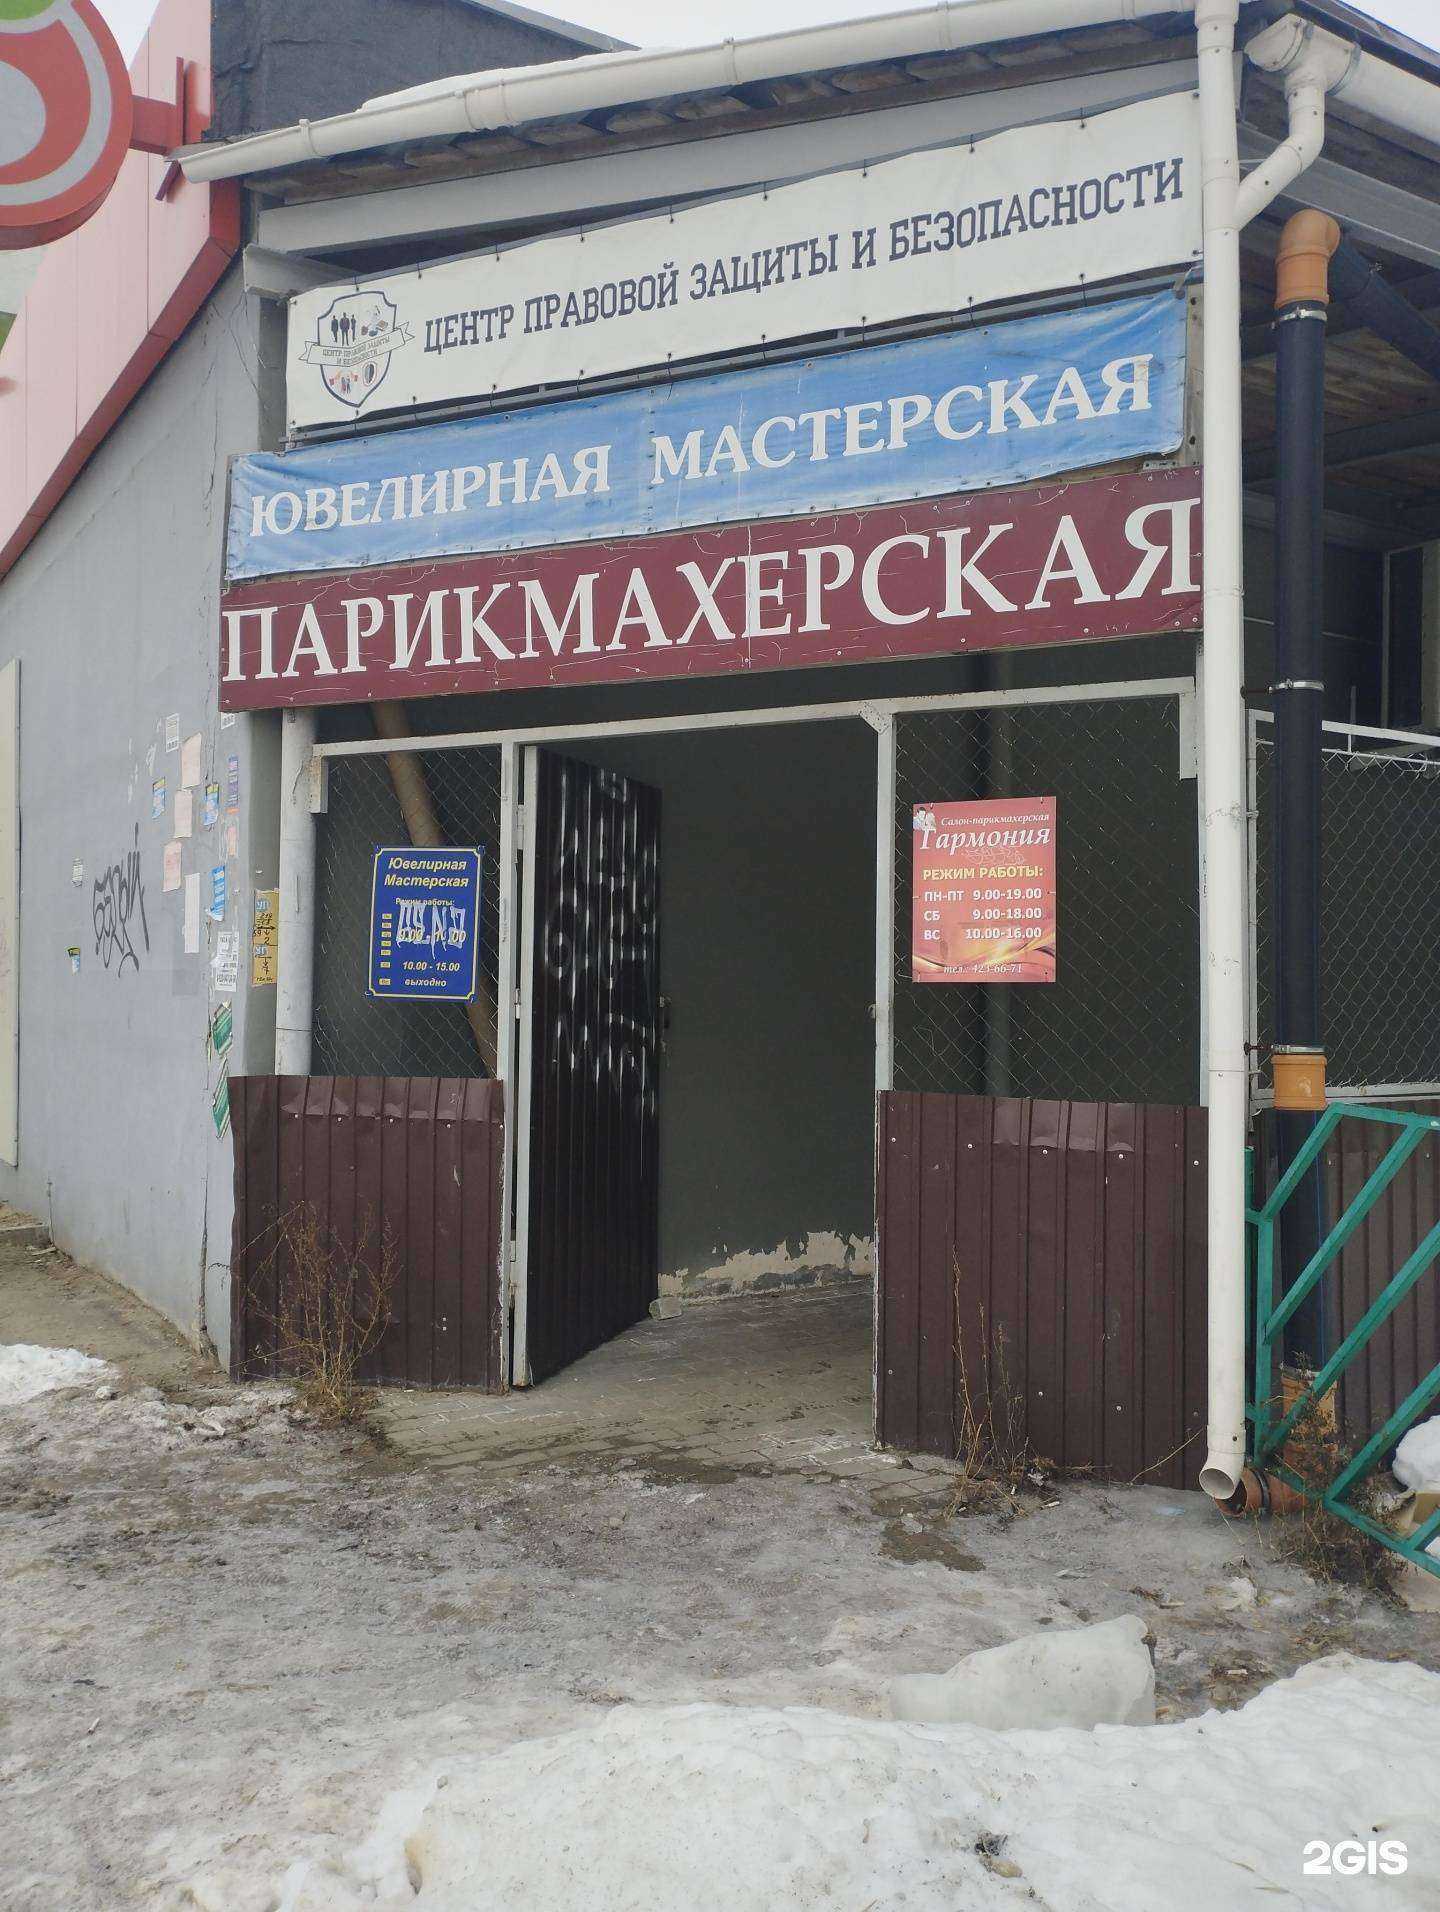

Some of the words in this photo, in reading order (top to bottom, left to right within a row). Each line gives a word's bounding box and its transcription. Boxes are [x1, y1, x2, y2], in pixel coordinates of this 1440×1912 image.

[424, 303, 514, 355] ЦЕНТР
[523, 261, 679, 333] ПРАВОВОЙ
[689, 233, 838, 300] ЗАЩИТЫ
[851, 227, 877, 270] И
[889, 157, 1184, 262] БЕЗОПАСНОСТИ
[249, 445, 613, 537] ЮВЕЛИРНАЯ
[649, 353, 1154, 485] МАСТЕРСКАЯ
[222, 497, 1201, 682] ПАРИКМАХЕРСКАЯ
[941, 813, 1050, 828] Салон-парикмахерская
[919, 828, 1051, 856] Гармония
[388, 857, 467, 873] Ювелирная
[922, 868, 976, 881] РЕЖИМ
[979, 865, 1044, 880] РАБОТЫ:
[384, 874, 470, 890] Мастерская
[924, 890, 965, 902] ПН-ПТ
[972, 888, 1042, 901] 9.00-19.00
[924, 910, 941, 921] СБ
[972, 908, 1042, 920] 9.00-18.00
[924, 929, 941, 940] ВС
[966, 927, 1042, 940] 10.00-16.00
[402, 961, 427, 971] 10.00
[435, 961, 461, 972] 15.00
